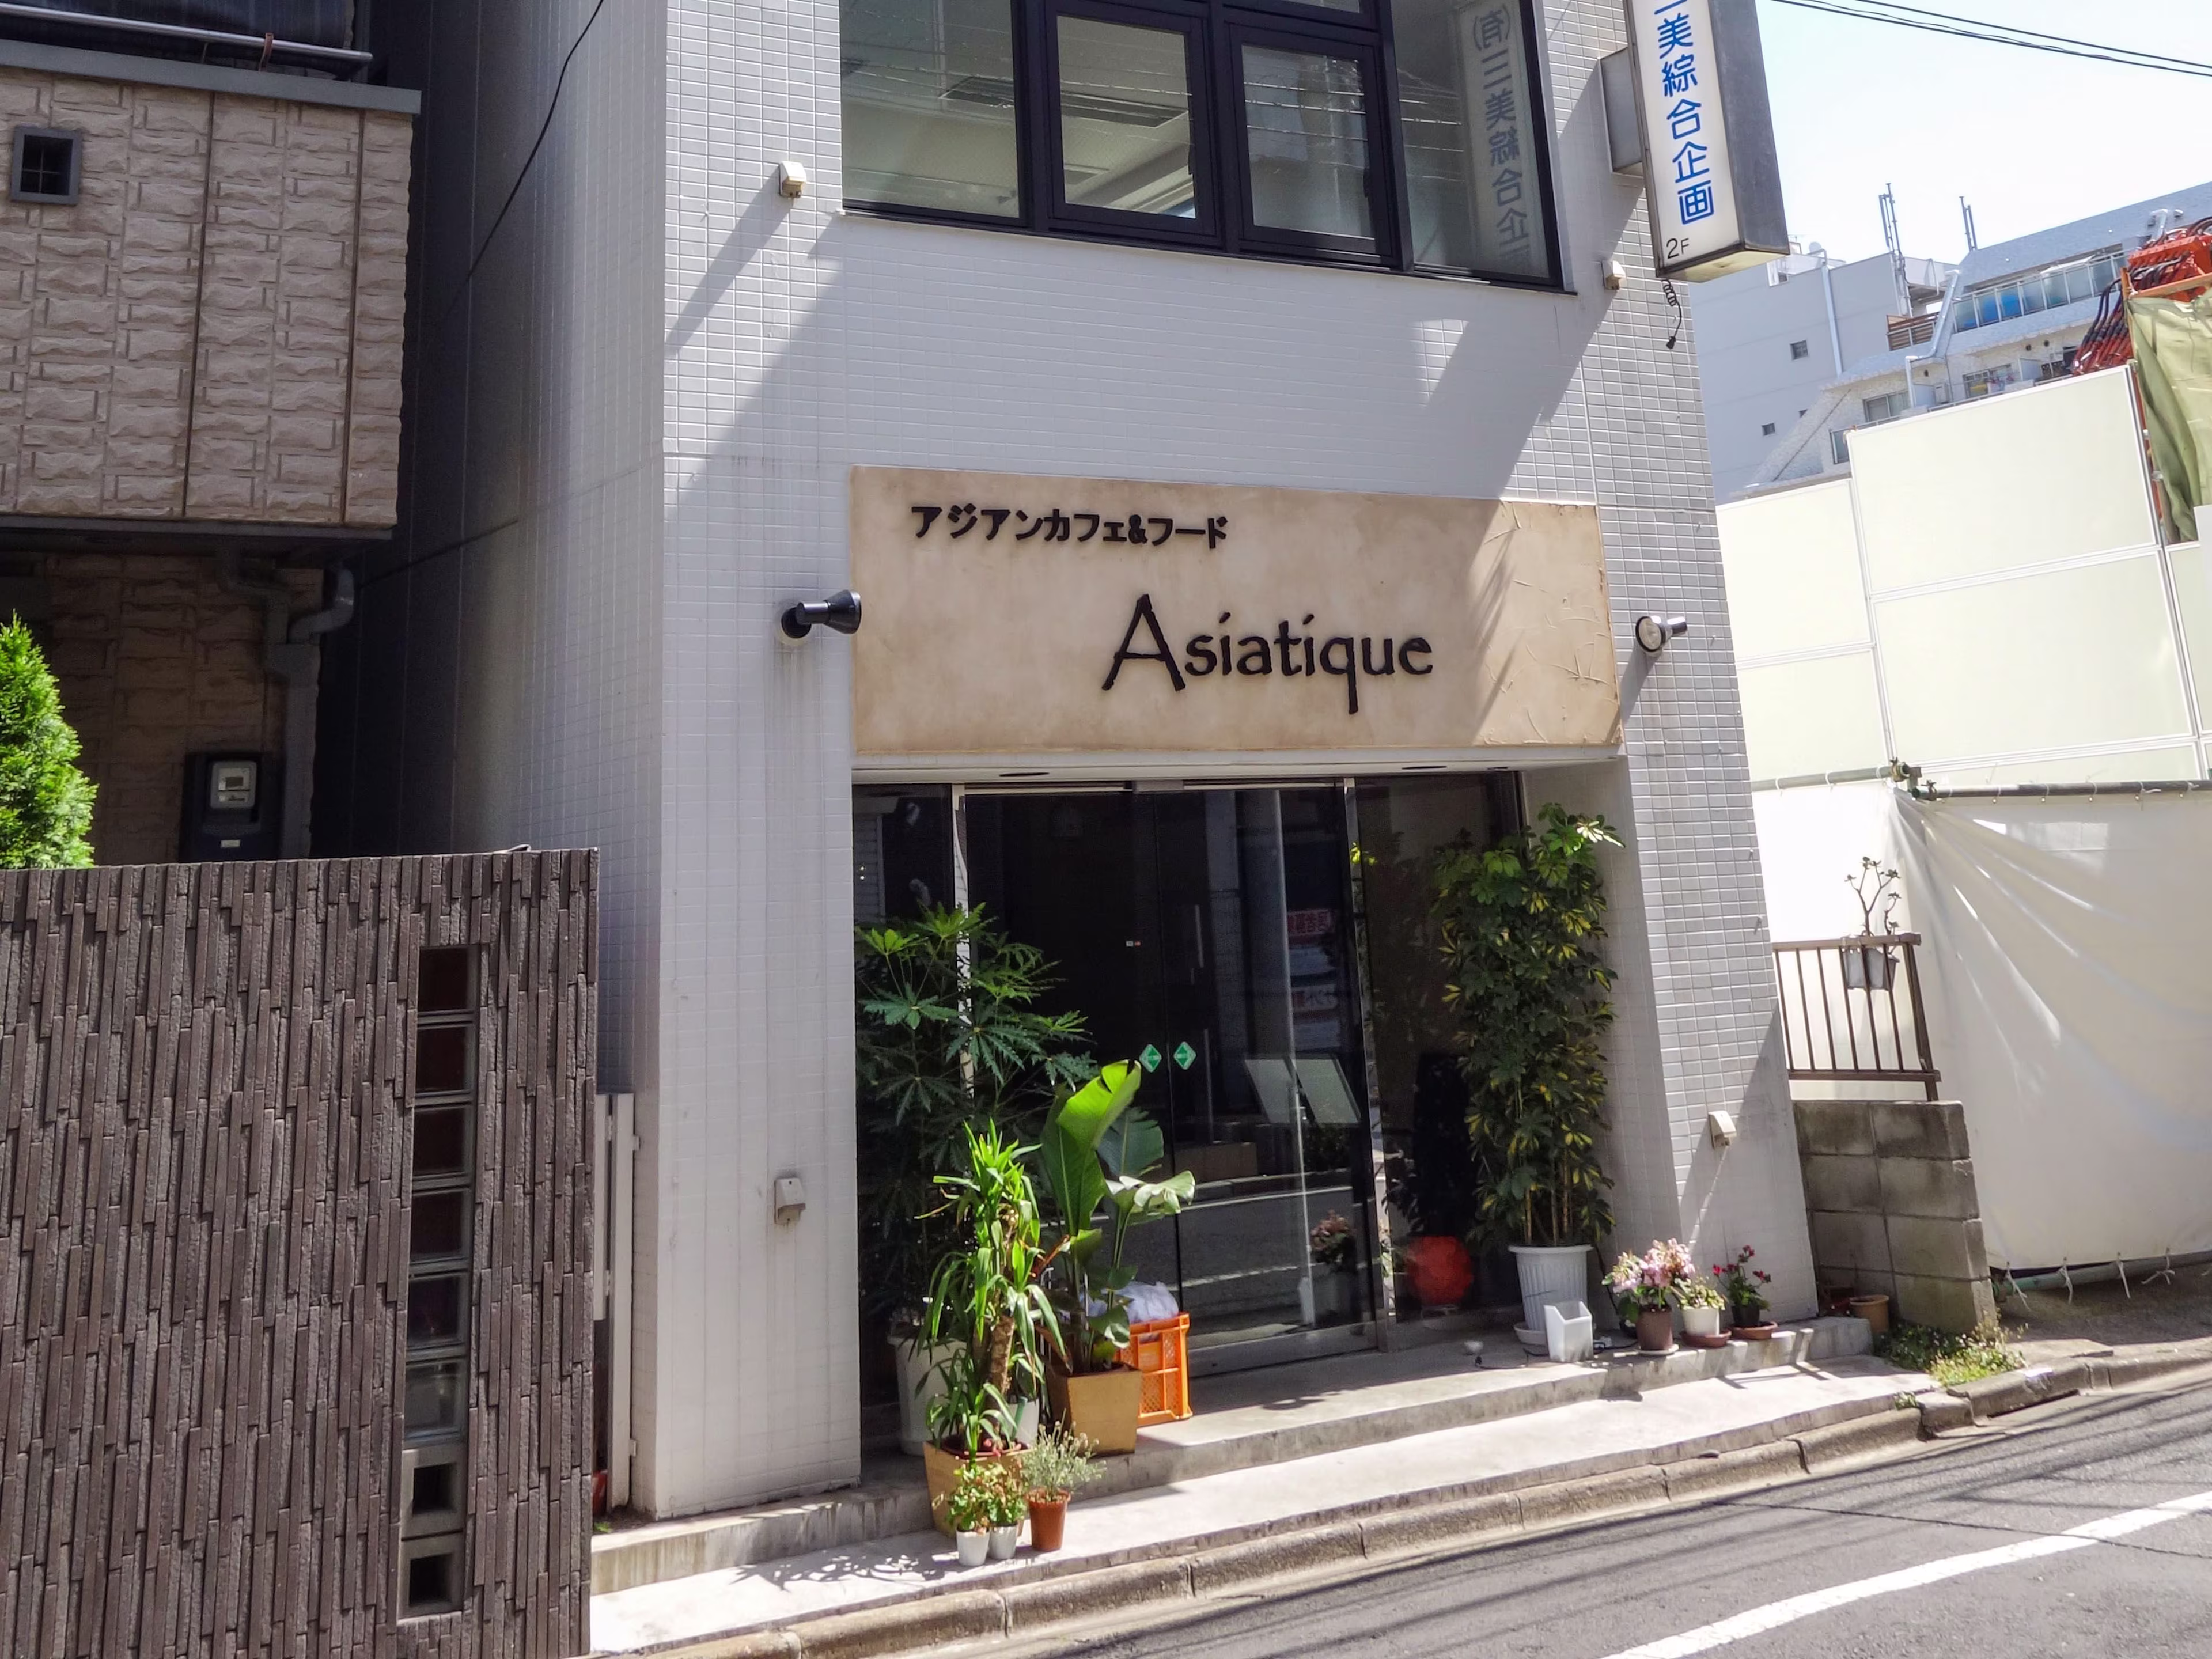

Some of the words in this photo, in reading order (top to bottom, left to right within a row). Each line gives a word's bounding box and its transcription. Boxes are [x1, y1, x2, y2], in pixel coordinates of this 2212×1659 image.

[1666, 238, 1690, 259] 2F
[911, 503, 1228, 549] アジアンカフェ&フード
[1101, 594, 1433, 714] Asiatique
